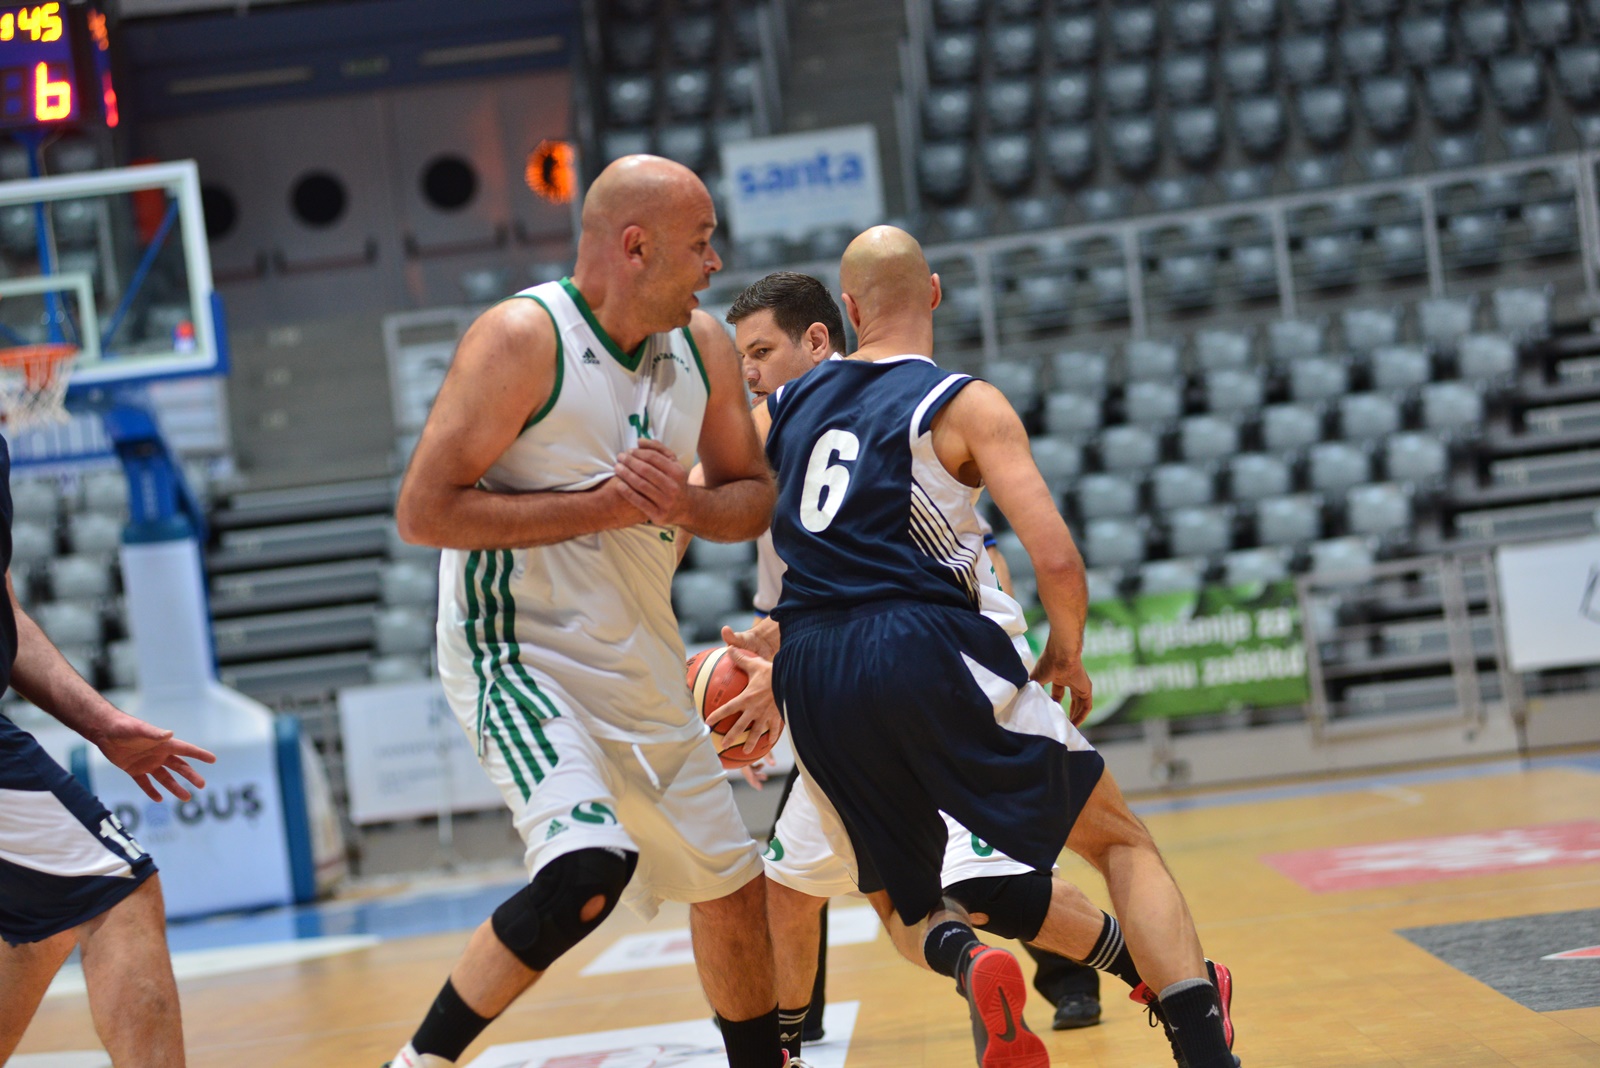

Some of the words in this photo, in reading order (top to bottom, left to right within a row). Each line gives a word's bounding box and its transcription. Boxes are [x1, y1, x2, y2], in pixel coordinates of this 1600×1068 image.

[738, 152, 863, 197] santa
[800, 428, 860, 533] 6
[1255, 606, 1293, 638] za
